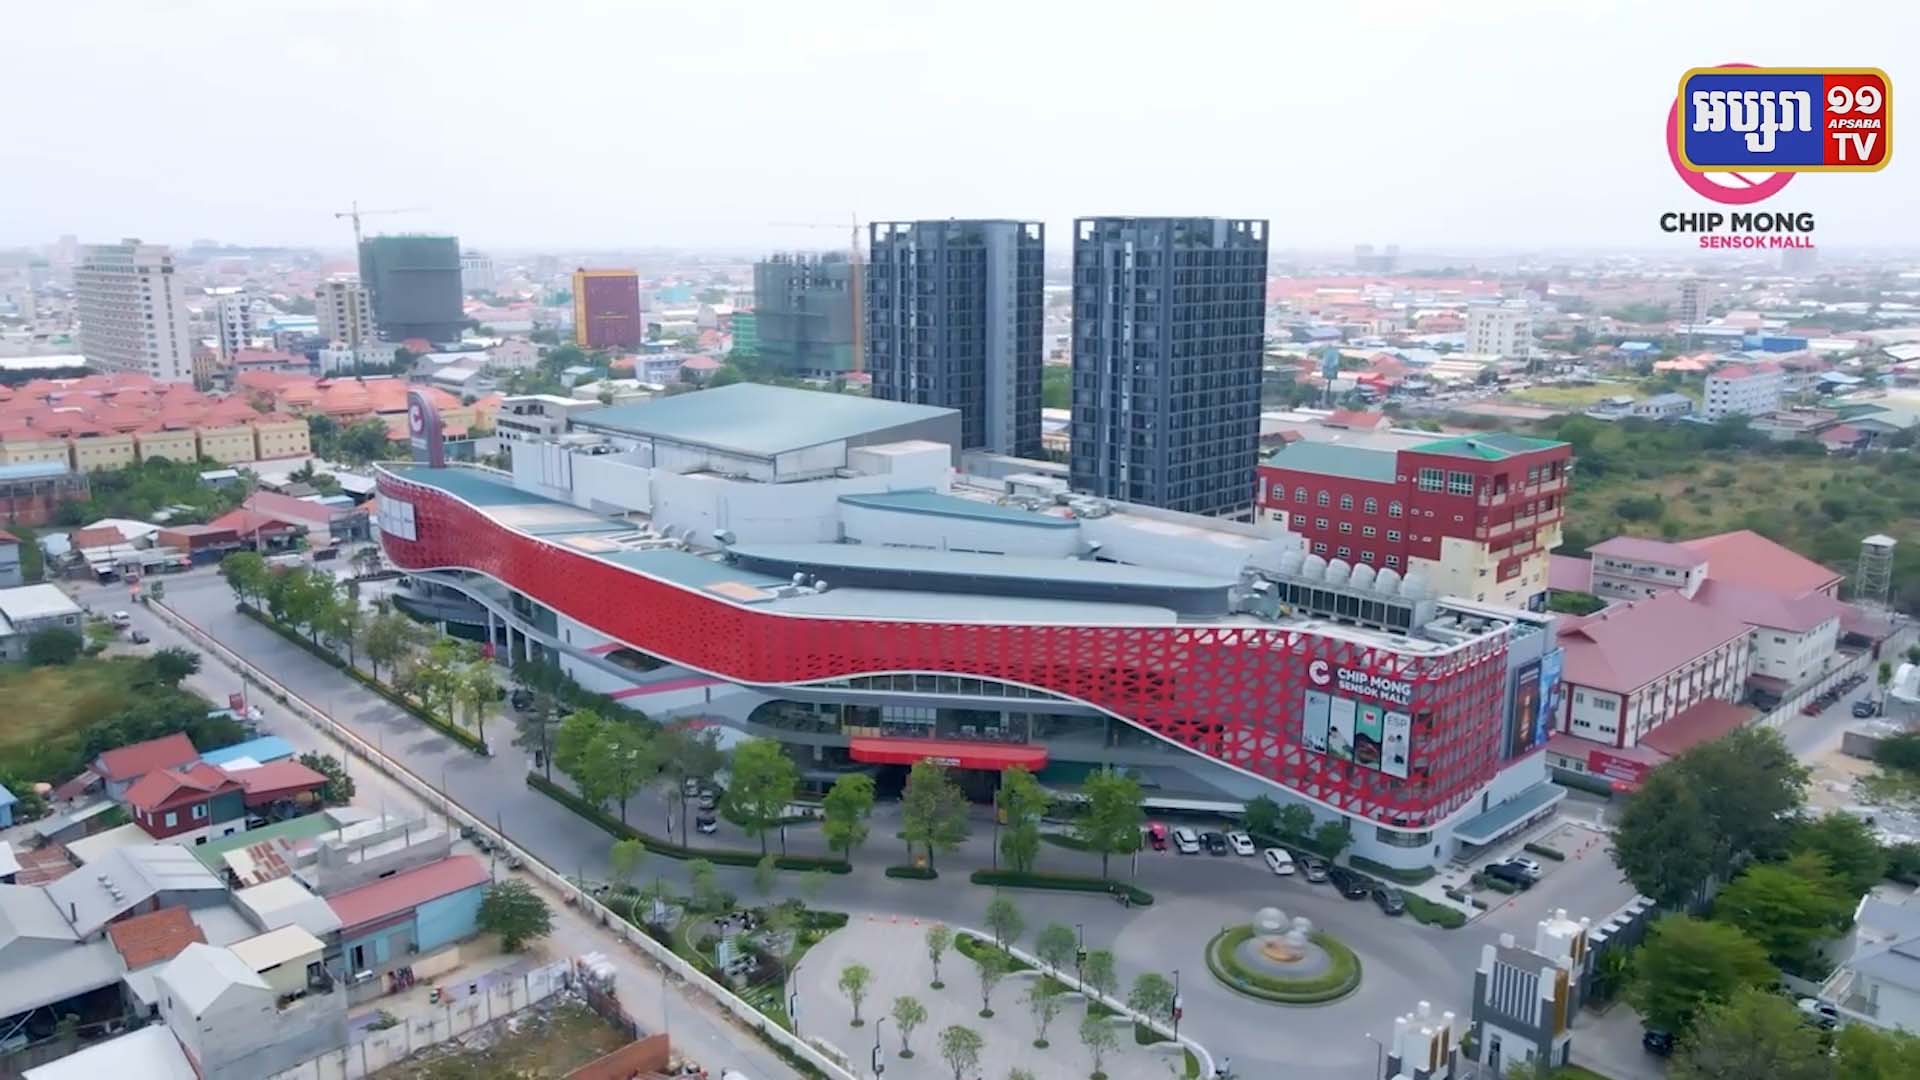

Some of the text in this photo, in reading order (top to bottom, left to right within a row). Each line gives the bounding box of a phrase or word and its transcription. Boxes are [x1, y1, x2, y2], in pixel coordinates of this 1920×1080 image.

[1337, 668, 1411, 695] CHIP MONG
[1339, 681, 1409, 706] SENSOK MALL
